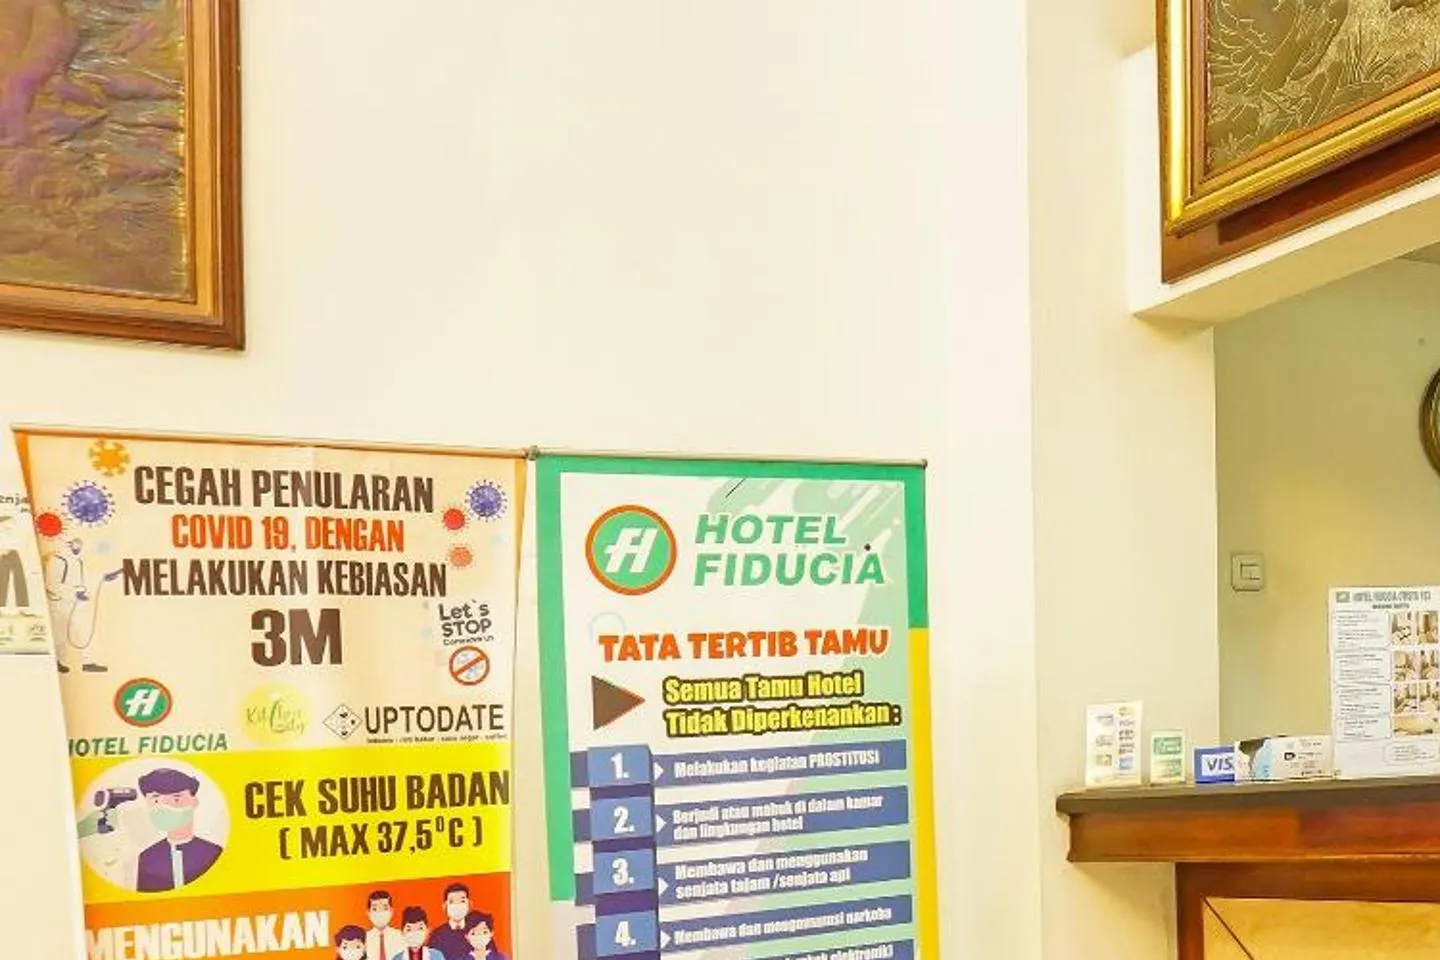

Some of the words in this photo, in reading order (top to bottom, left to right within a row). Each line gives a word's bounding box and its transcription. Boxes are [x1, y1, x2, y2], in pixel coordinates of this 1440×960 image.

[134, 466, 241, 506] CEGAH
[253, 470, 433, 513] PENULARAN
[171, 514, 251, 549] COVID
[305, 516, 404, 552] DENGAN
[694, 514, 847, 545] HOTEL
[122, 558, 307, 596] MELAKUKAN
[317, 559, 446, 597] KEBIASAN
[693, 552, 885, 587] FIDUCIA
[251, 608, 342, 667] 3M
[441, 618, 492, 637] STOP
[599, 632, 681, 662] TATA
[687, 630, 798, 659] TERTIB
[804, 629, 889, 656] TAMU
[663, 675, 743, 705] Semua
[745, 672, 805, 702] Tamu
[807, 670, 863, 698] Hotel
[365, 704, 503, 734] UPTODATE
[663, 707, 729, 737] Tidak
[138, 733, 228, 754] FIDUCIA
[610, 752, 629, 779] 1.
[674, 759, 748, 778] Melakukan
[751, 756, 807, 774] kegiatan
[809, 750, 880, 768] PROSTITUSI
[1207, 757, 1234, 771] VIS
[244, 779, 307, 819] CEK
[318, 775, 397, 815] SUHU
[406, 770, 510, 811] BADAN
[613, 806, 635, 834] 2.
[772, 816, 803, 831] hotel
[300, 822, 370, 858] MAX
[612, 858, 634, 886] 3.
[675, 861, 746, 880] Membawa
[748, 857, 774, 872] dan
[675, 880, 729, 899] senjata
[730, 876, 771, 893] tajam
[829, 867, 851, 883] api
[614, 921, 637, 947] 4.
[673, 924, 737, 945] Membawa
